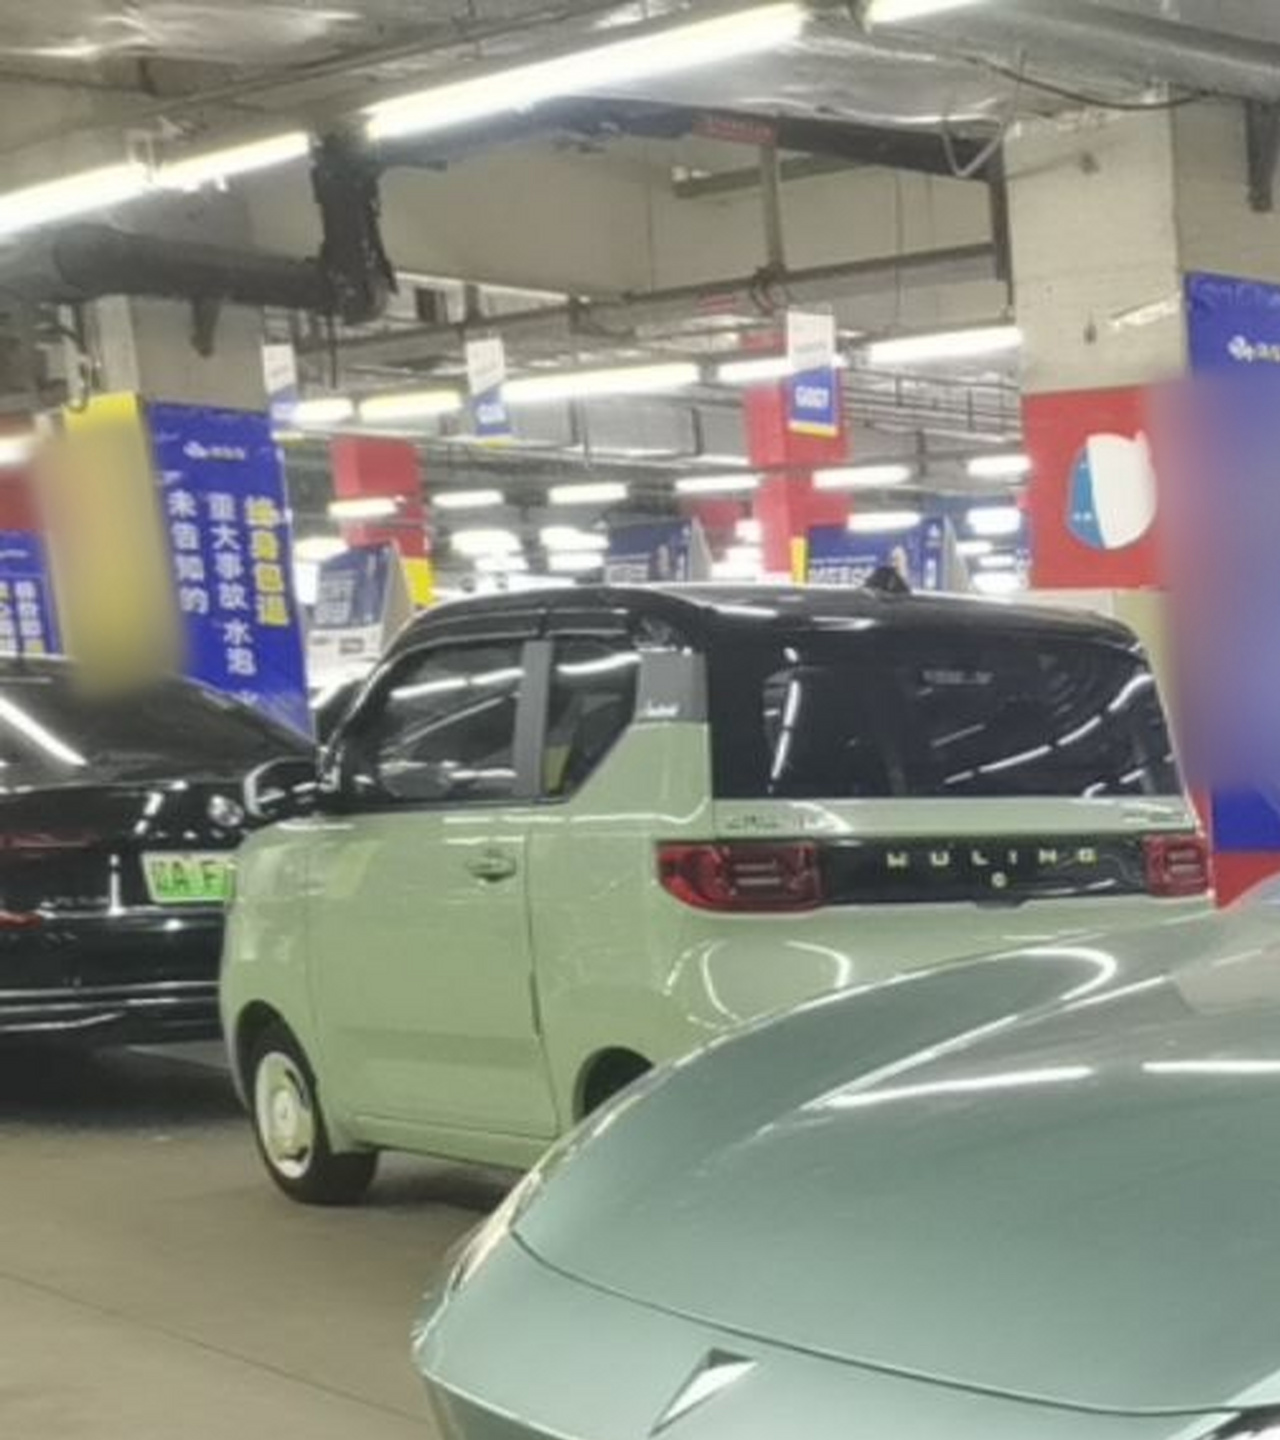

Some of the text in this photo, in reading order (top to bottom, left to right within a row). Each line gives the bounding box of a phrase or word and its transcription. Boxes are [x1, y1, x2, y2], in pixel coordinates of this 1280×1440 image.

[207, 492, 249, 611] 重大事故
[886, 848, 1097, 867] WULING
